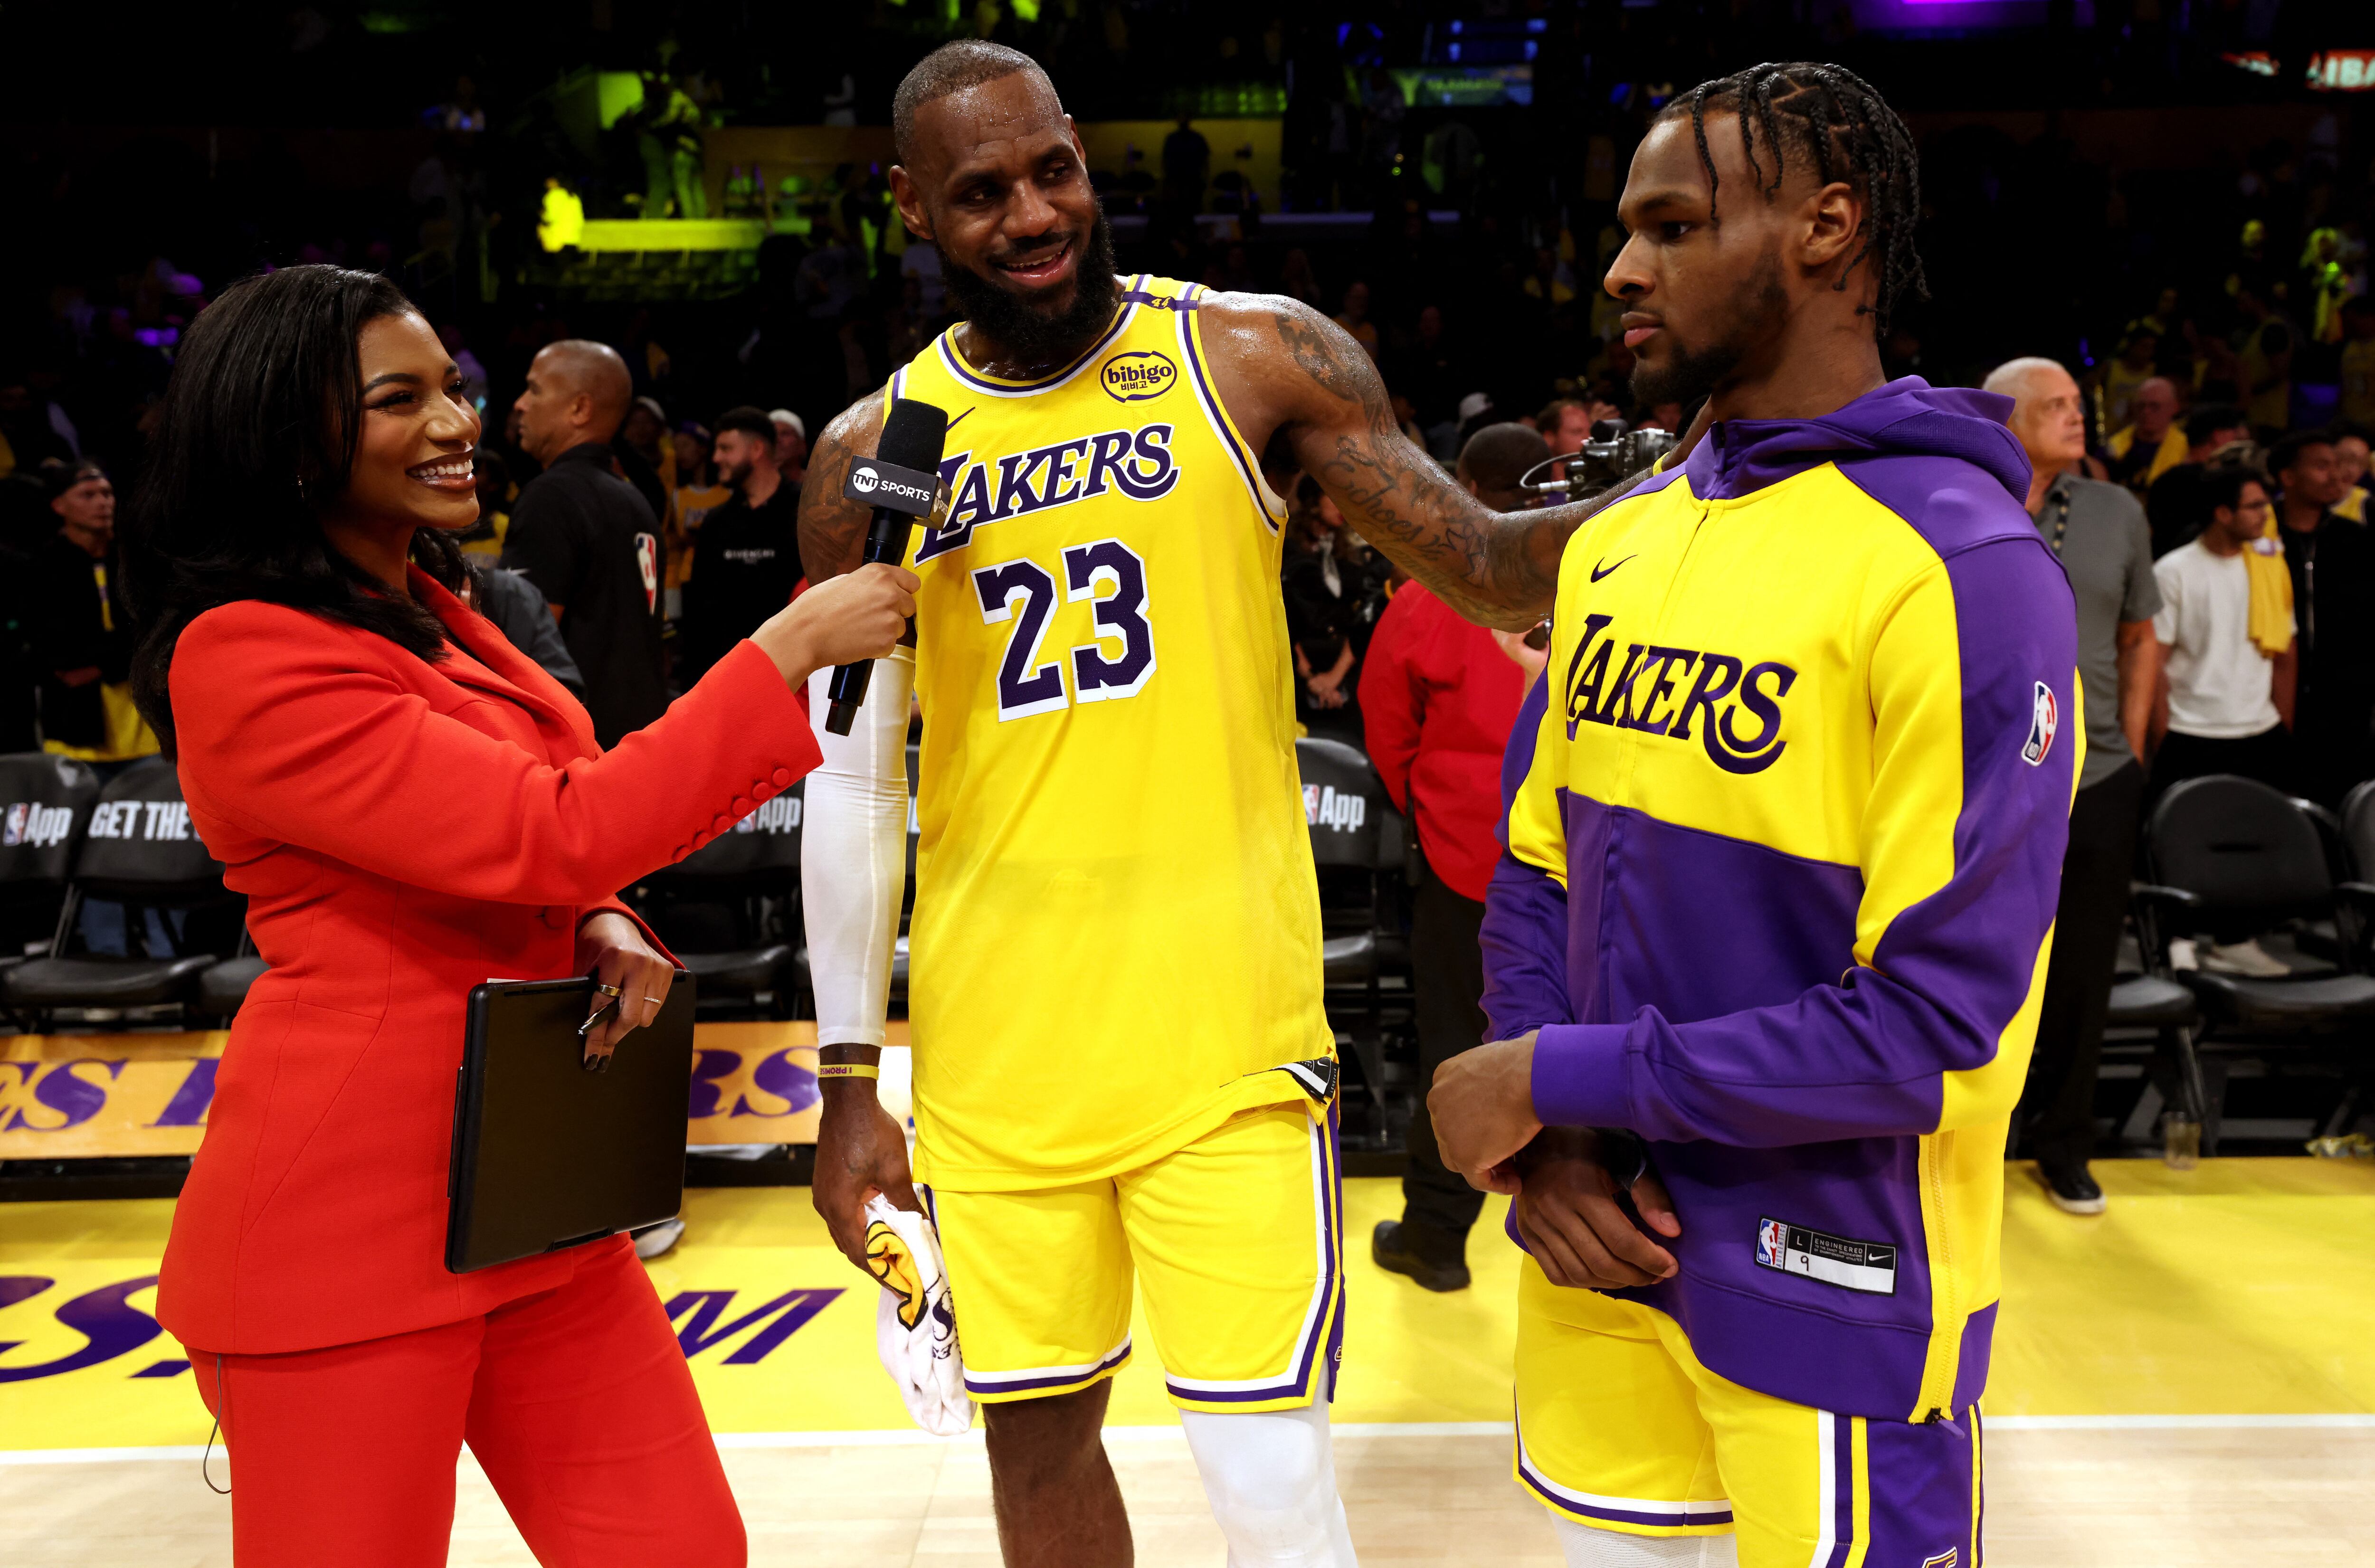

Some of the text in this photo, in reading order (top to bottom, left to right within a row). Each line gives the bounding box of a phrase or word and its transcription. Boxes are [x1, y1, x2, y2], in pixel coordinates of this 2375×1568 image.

[1151, 297, 1171, 307] 44
[1107, 364, 1172, 384] bibigo
[1121, 381, 1148, 391] 비비고
[854, 472, 930, 501] TNT SPORTS
[913, 422, 1182, 568] LAKERS
[970, 537, 1158, 723] 23
[1566, 614, 1798, 775] LAKERS
[88, 800, 190, 841] GET THE
[758, 796, 802, 834] App
[1319, 785, 1365, 833] App
[23, 801, 74, 848] App
[820, 1067, 847, 1075] PROMISE
[1796, 1235, 1803, 1246] L
[1814, 1238, 1863, 1255] ENGINEERED
[1758, 1252, 1769, 1262] NBA
[1800, 1255, 1809, 1272] 9
